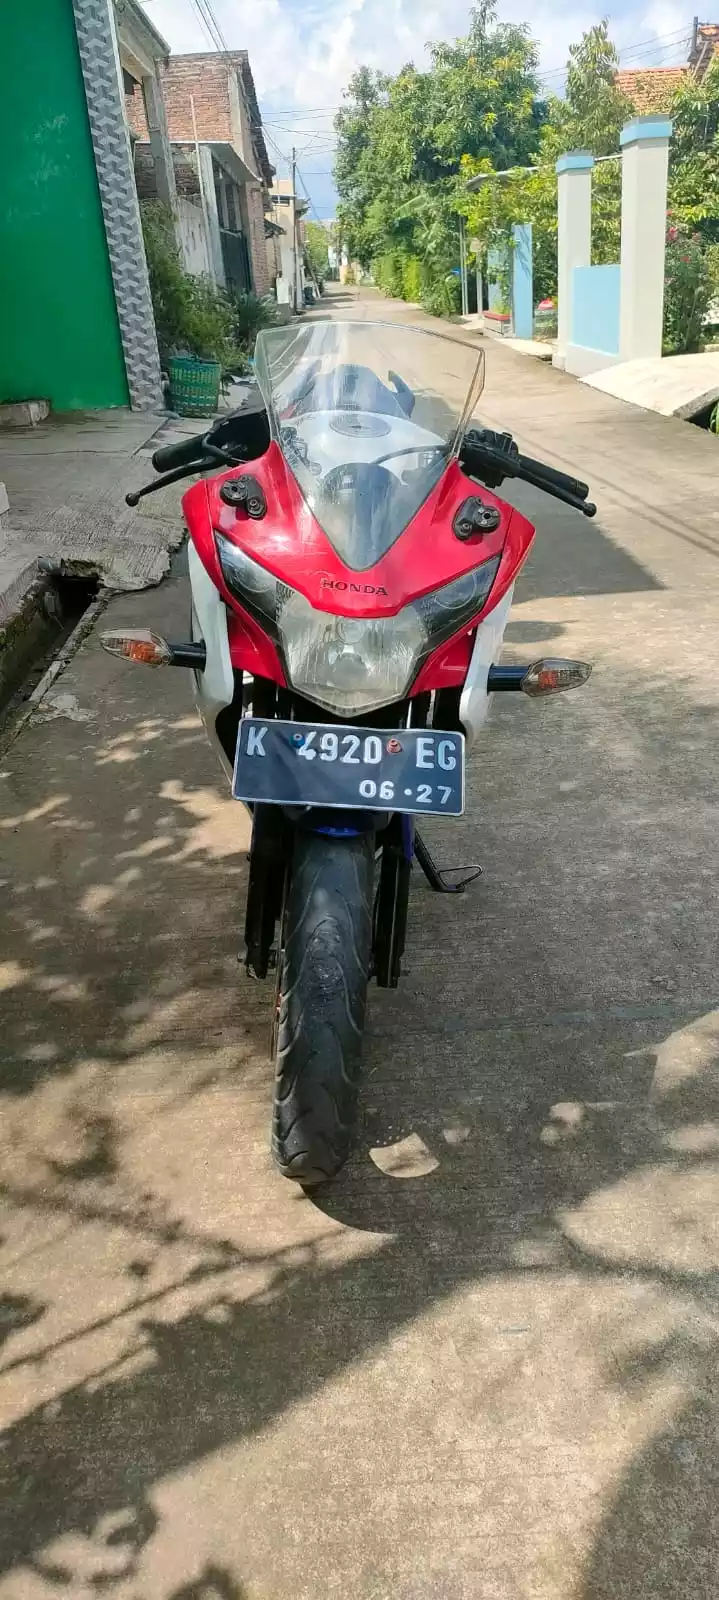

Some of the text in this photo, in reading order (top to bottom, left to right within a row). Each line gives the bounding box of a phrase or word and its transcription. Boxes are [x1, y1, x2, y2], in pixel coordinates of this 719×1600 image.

[322, 579, 388, 596] HONDA
[246, 726, 456, 771] K 4920 EG
